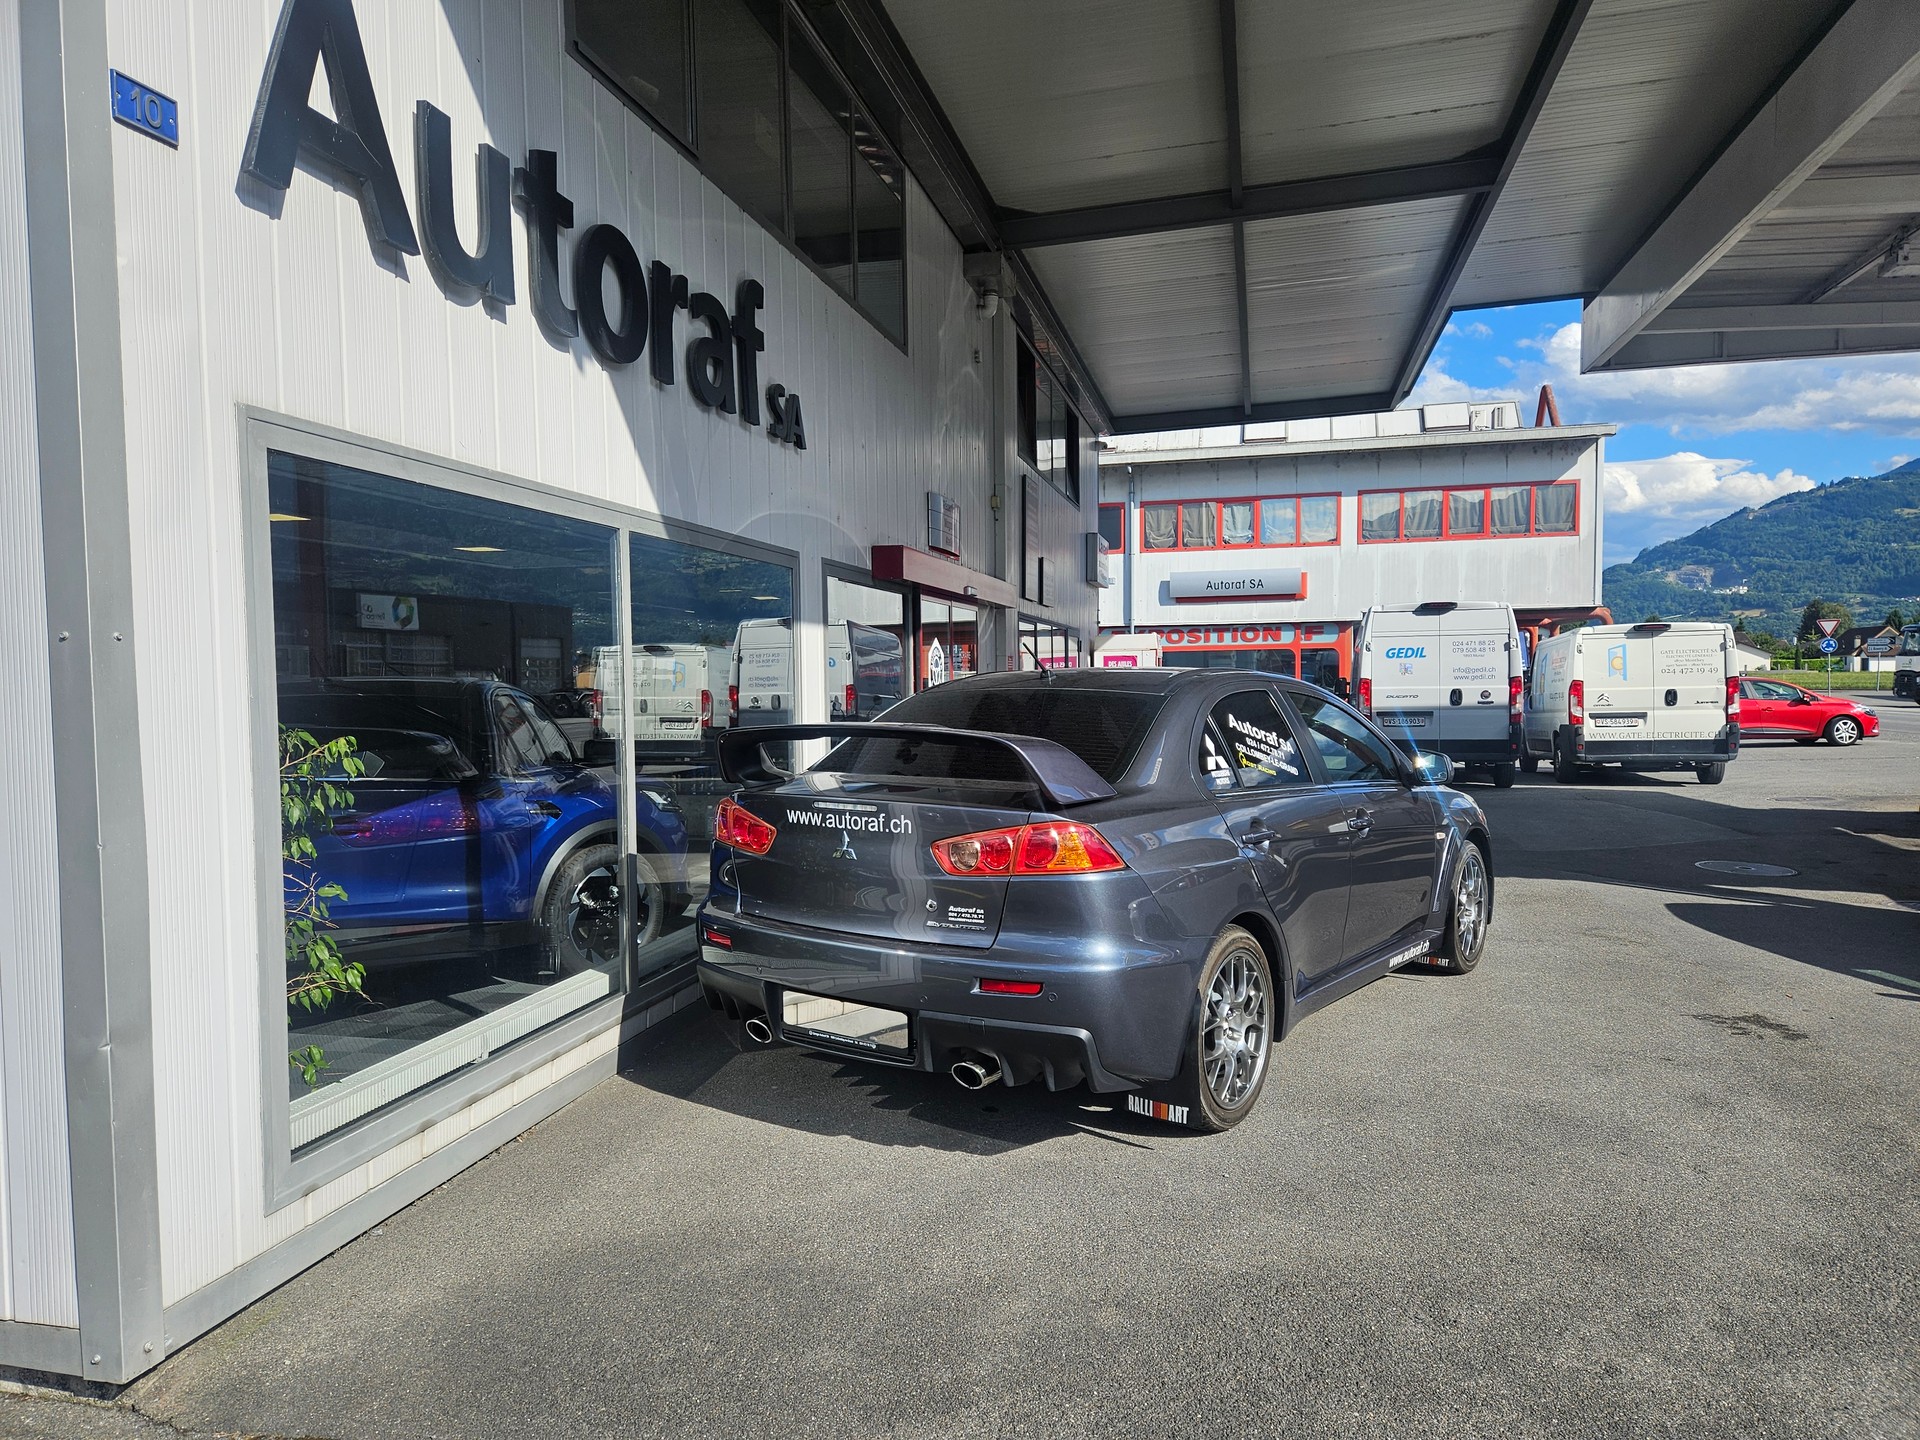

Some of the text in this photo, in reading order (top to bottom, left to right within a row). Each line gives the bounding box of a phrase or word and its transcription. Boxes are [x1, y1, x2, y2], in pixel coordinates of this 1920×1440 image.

[130, 87, 162, 129] 10
[242, 0, 807, 451] Autoraf SA
[1206, 579, 1264, 590] Autoraf SA
[1385, 647, 1426, 658] GEDIL
[1679, 667, 1694, 675] 472
[1228, 713, 1295, 754] Autoraf SA
[786, 809, 912, 834] www.autoraf.ch
[948, 905, 976, 913] Autoraf
[1437, 958, 1449, 966] ART
[1128, 1094, 1189, 1124] RALLI ART
